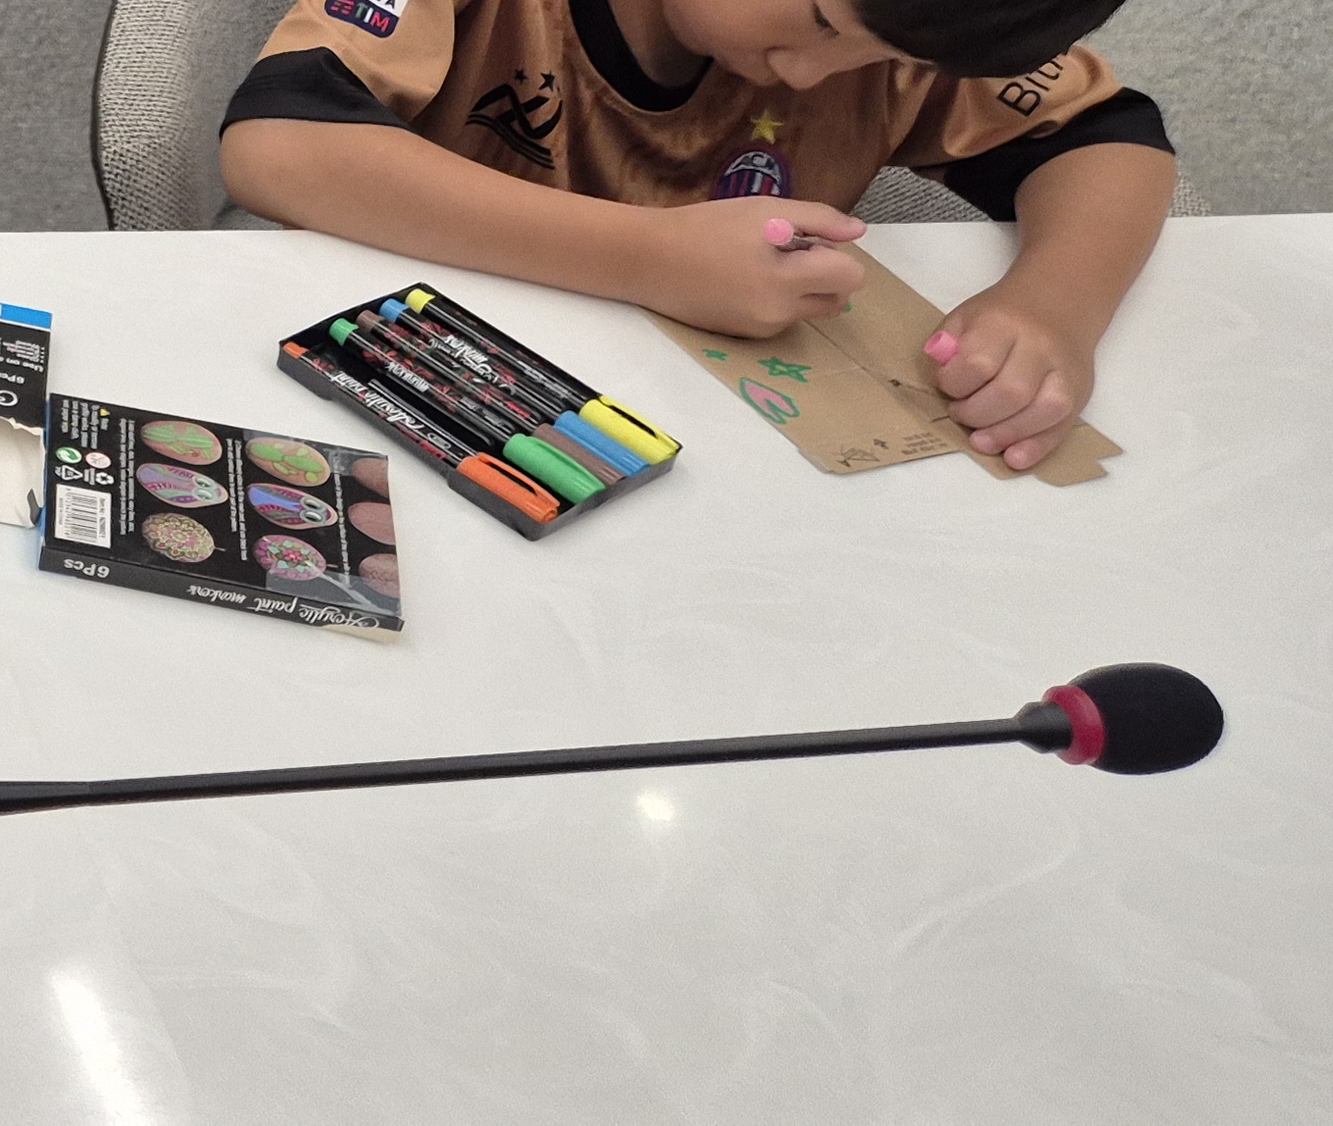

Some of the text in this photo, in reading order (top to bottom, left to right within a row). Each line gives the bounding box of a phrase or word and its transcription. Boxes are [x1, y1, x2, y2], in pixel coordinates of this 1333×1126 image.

[355, 1, 390, 33] TIM
[22, 361, 44, 373] Use
[63, 559, 111, 579] 6Pcs
[187, 584, 380, 628] Acrylic paint markers
